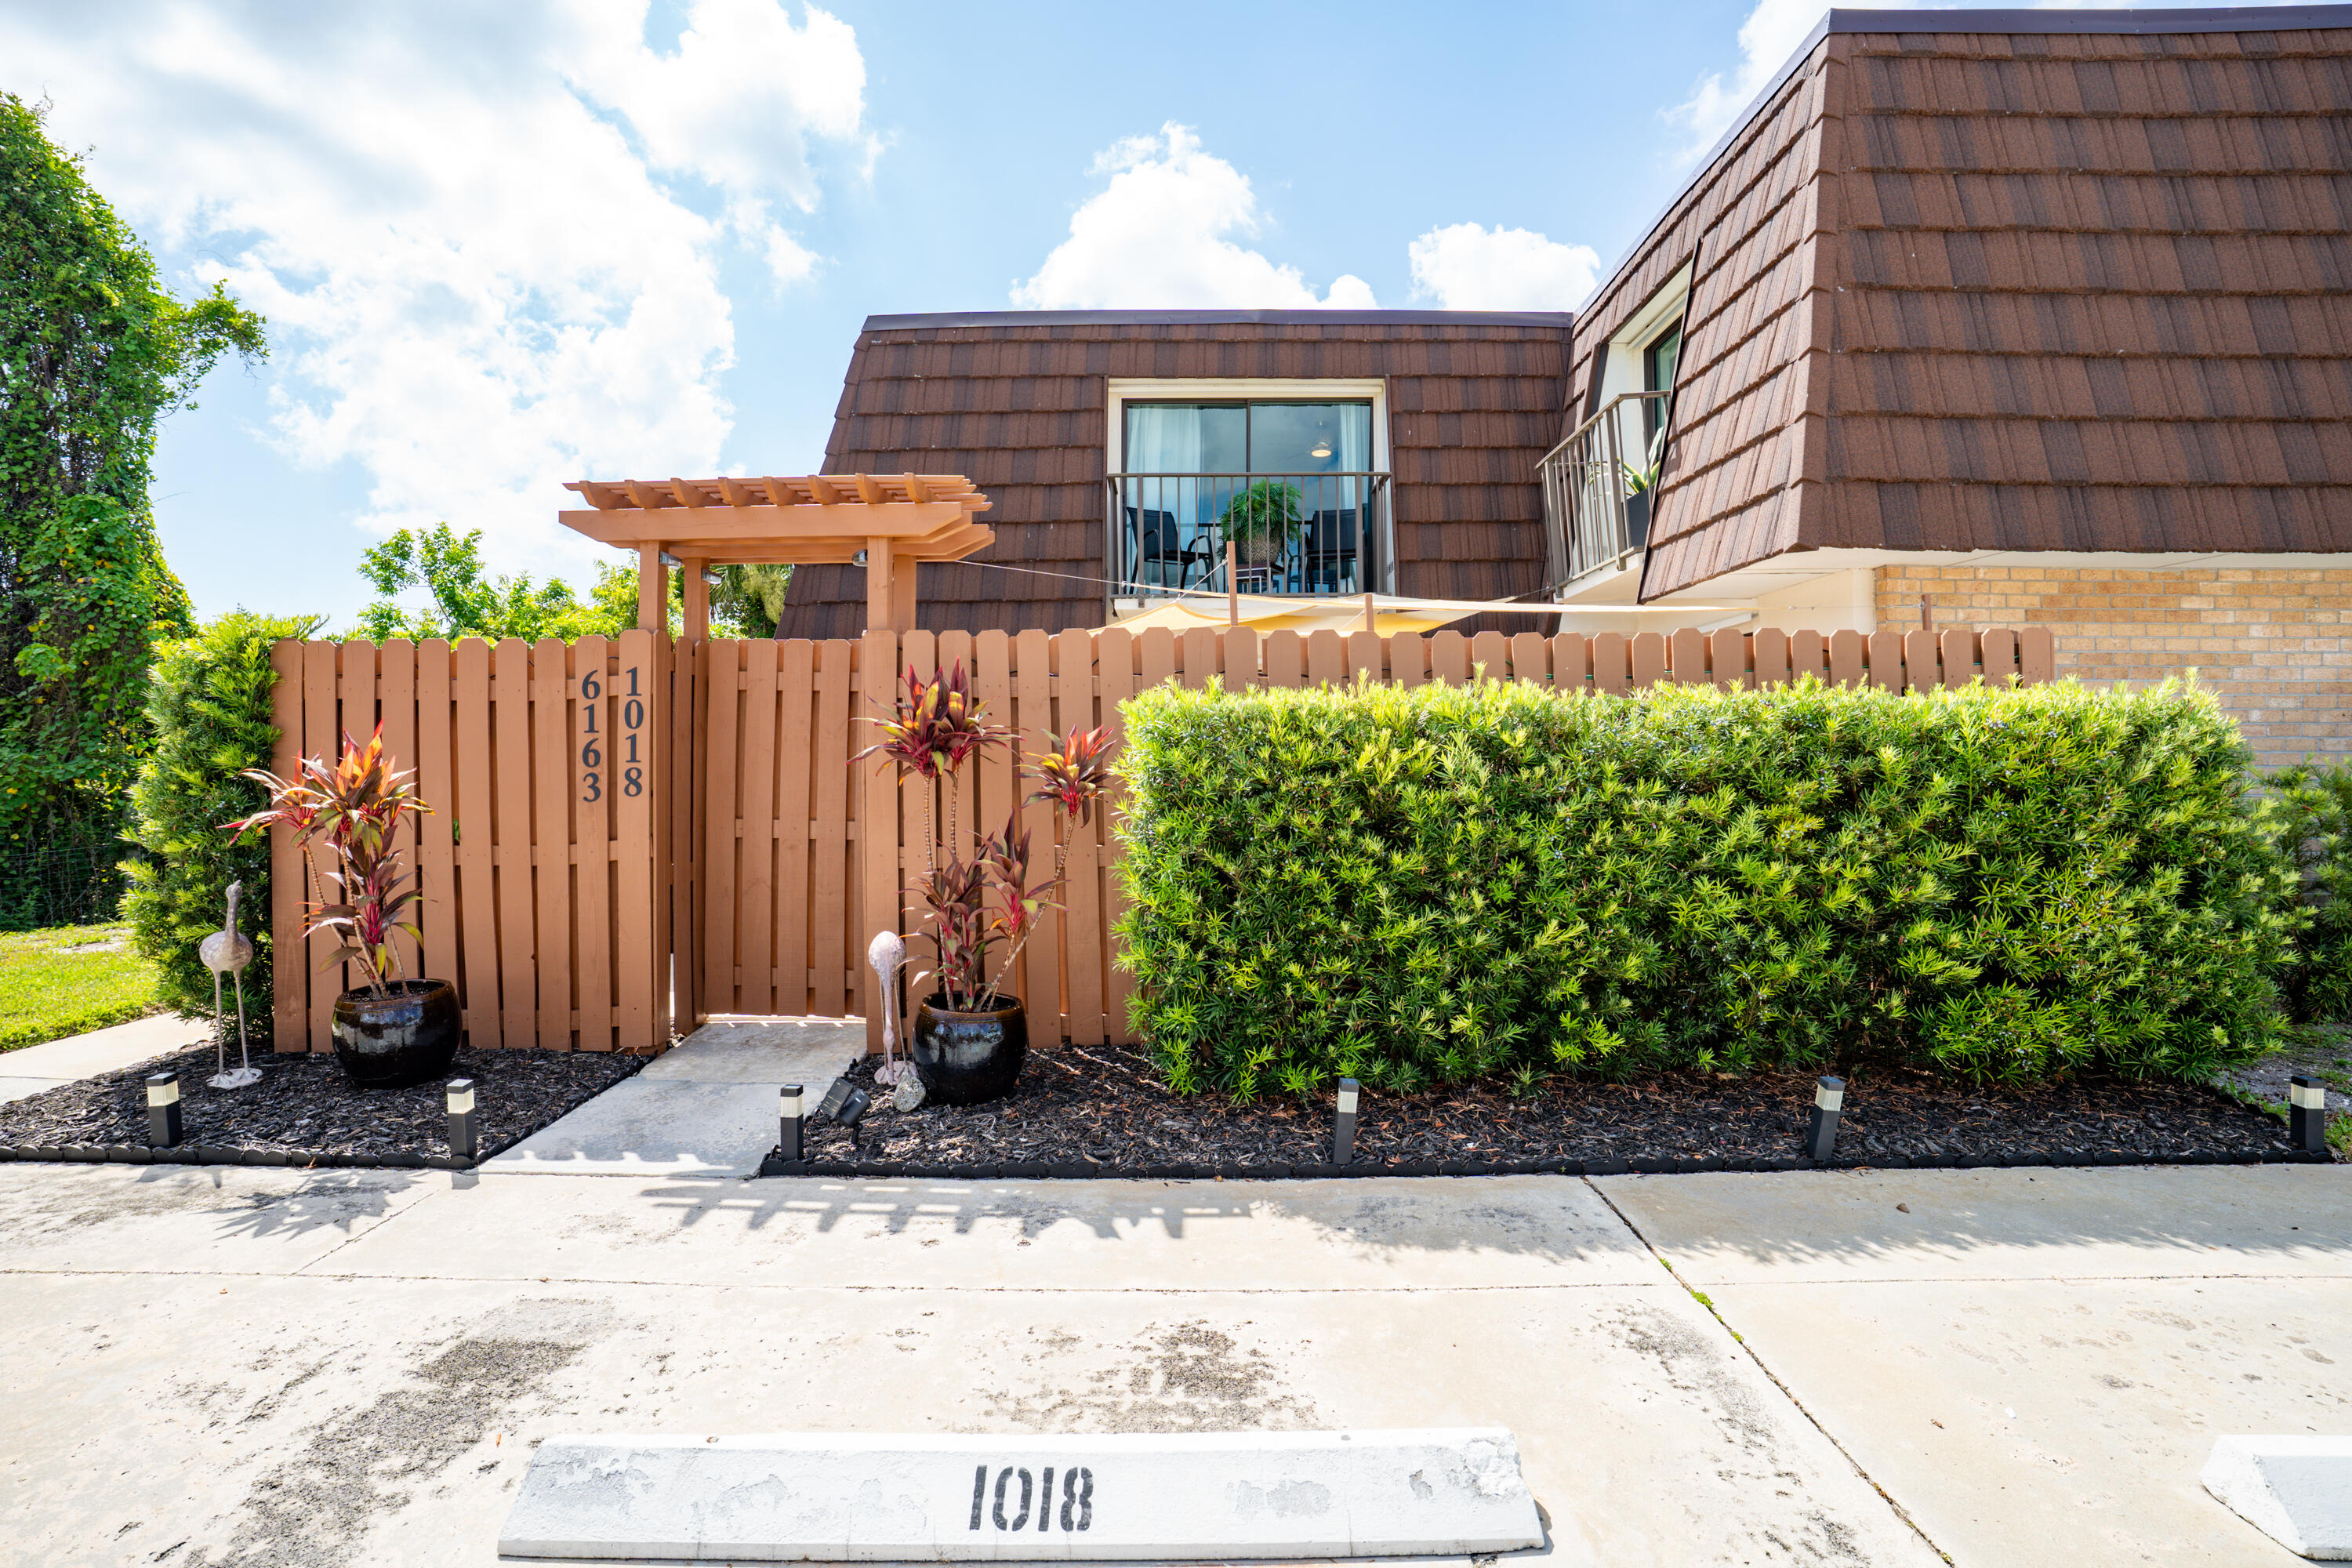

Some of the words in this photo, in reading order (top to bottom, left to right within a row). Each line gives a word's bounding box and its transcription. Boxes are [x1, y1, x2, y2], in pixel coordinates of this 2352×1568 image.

[582, 670, 601, 802] 6163
[624, 666, 644, 797] 1018
[969, 1465, 1094, 1532] 1018
